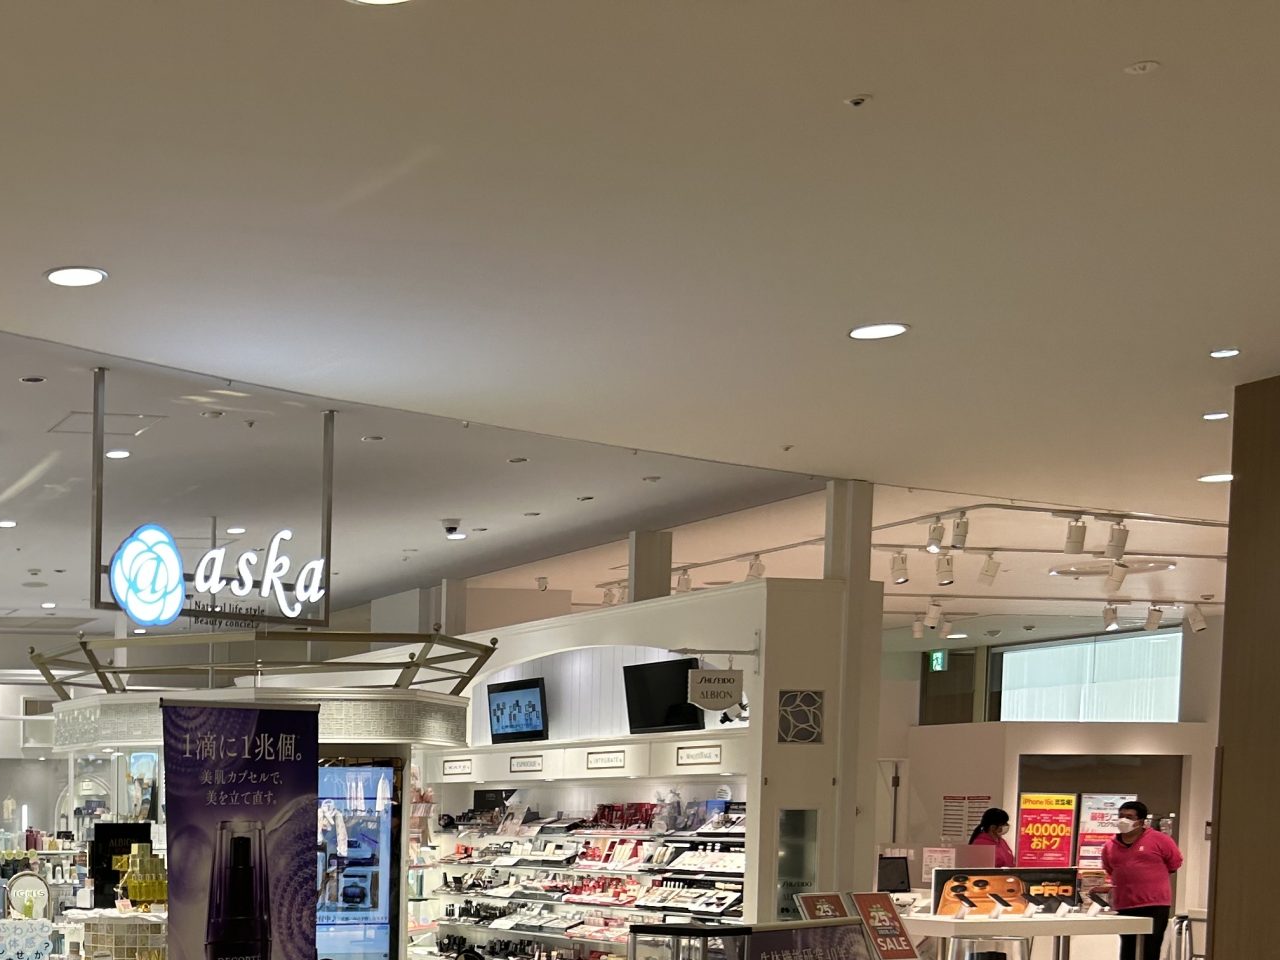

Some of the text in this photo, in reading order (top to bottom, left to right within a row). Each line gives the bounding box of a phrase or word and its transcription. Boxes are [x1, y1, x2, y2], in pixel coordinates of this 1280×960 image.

[193, 529, 325, 618] aska
[229, 603, 242, 614] life
[245, 605, 265, 617] style
[697, 677, 735, 685] SHISEIDO
[700, 690, 733, 700] ALBION
[182, 732, 302, 762] 1滴に1兆個。
[14, 890, 45, 898] IGNIS
[0, 922, 50, 935] ふわふわ
[877, 937, 910, 951] SALE
